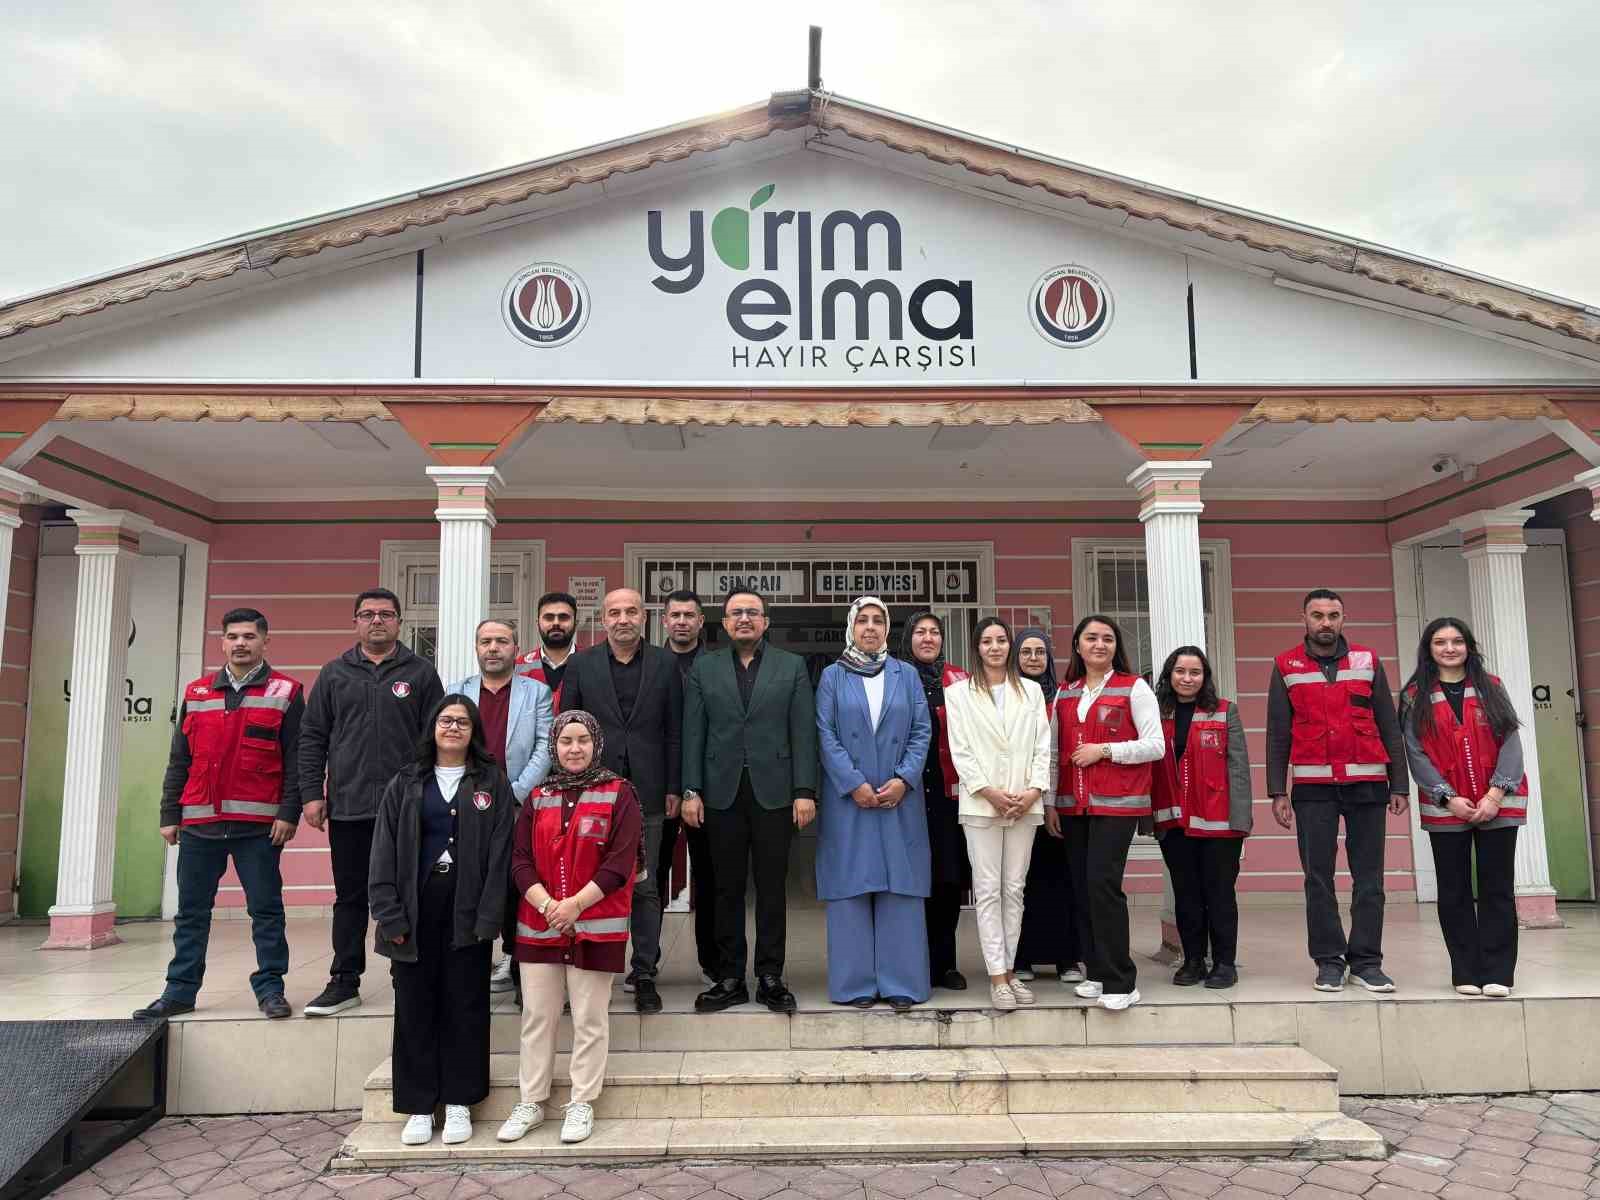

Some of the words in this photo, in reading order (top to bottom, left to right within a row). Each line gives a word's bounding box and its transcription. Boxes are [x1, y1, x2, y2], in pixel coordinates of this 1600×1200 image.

[648, 206, 902, 294] yarım
[726, 262, 974, 341] elma
[732, 346, 828, 368] HAYIR
[845, 346, 976, 373] ÇARŞISI
